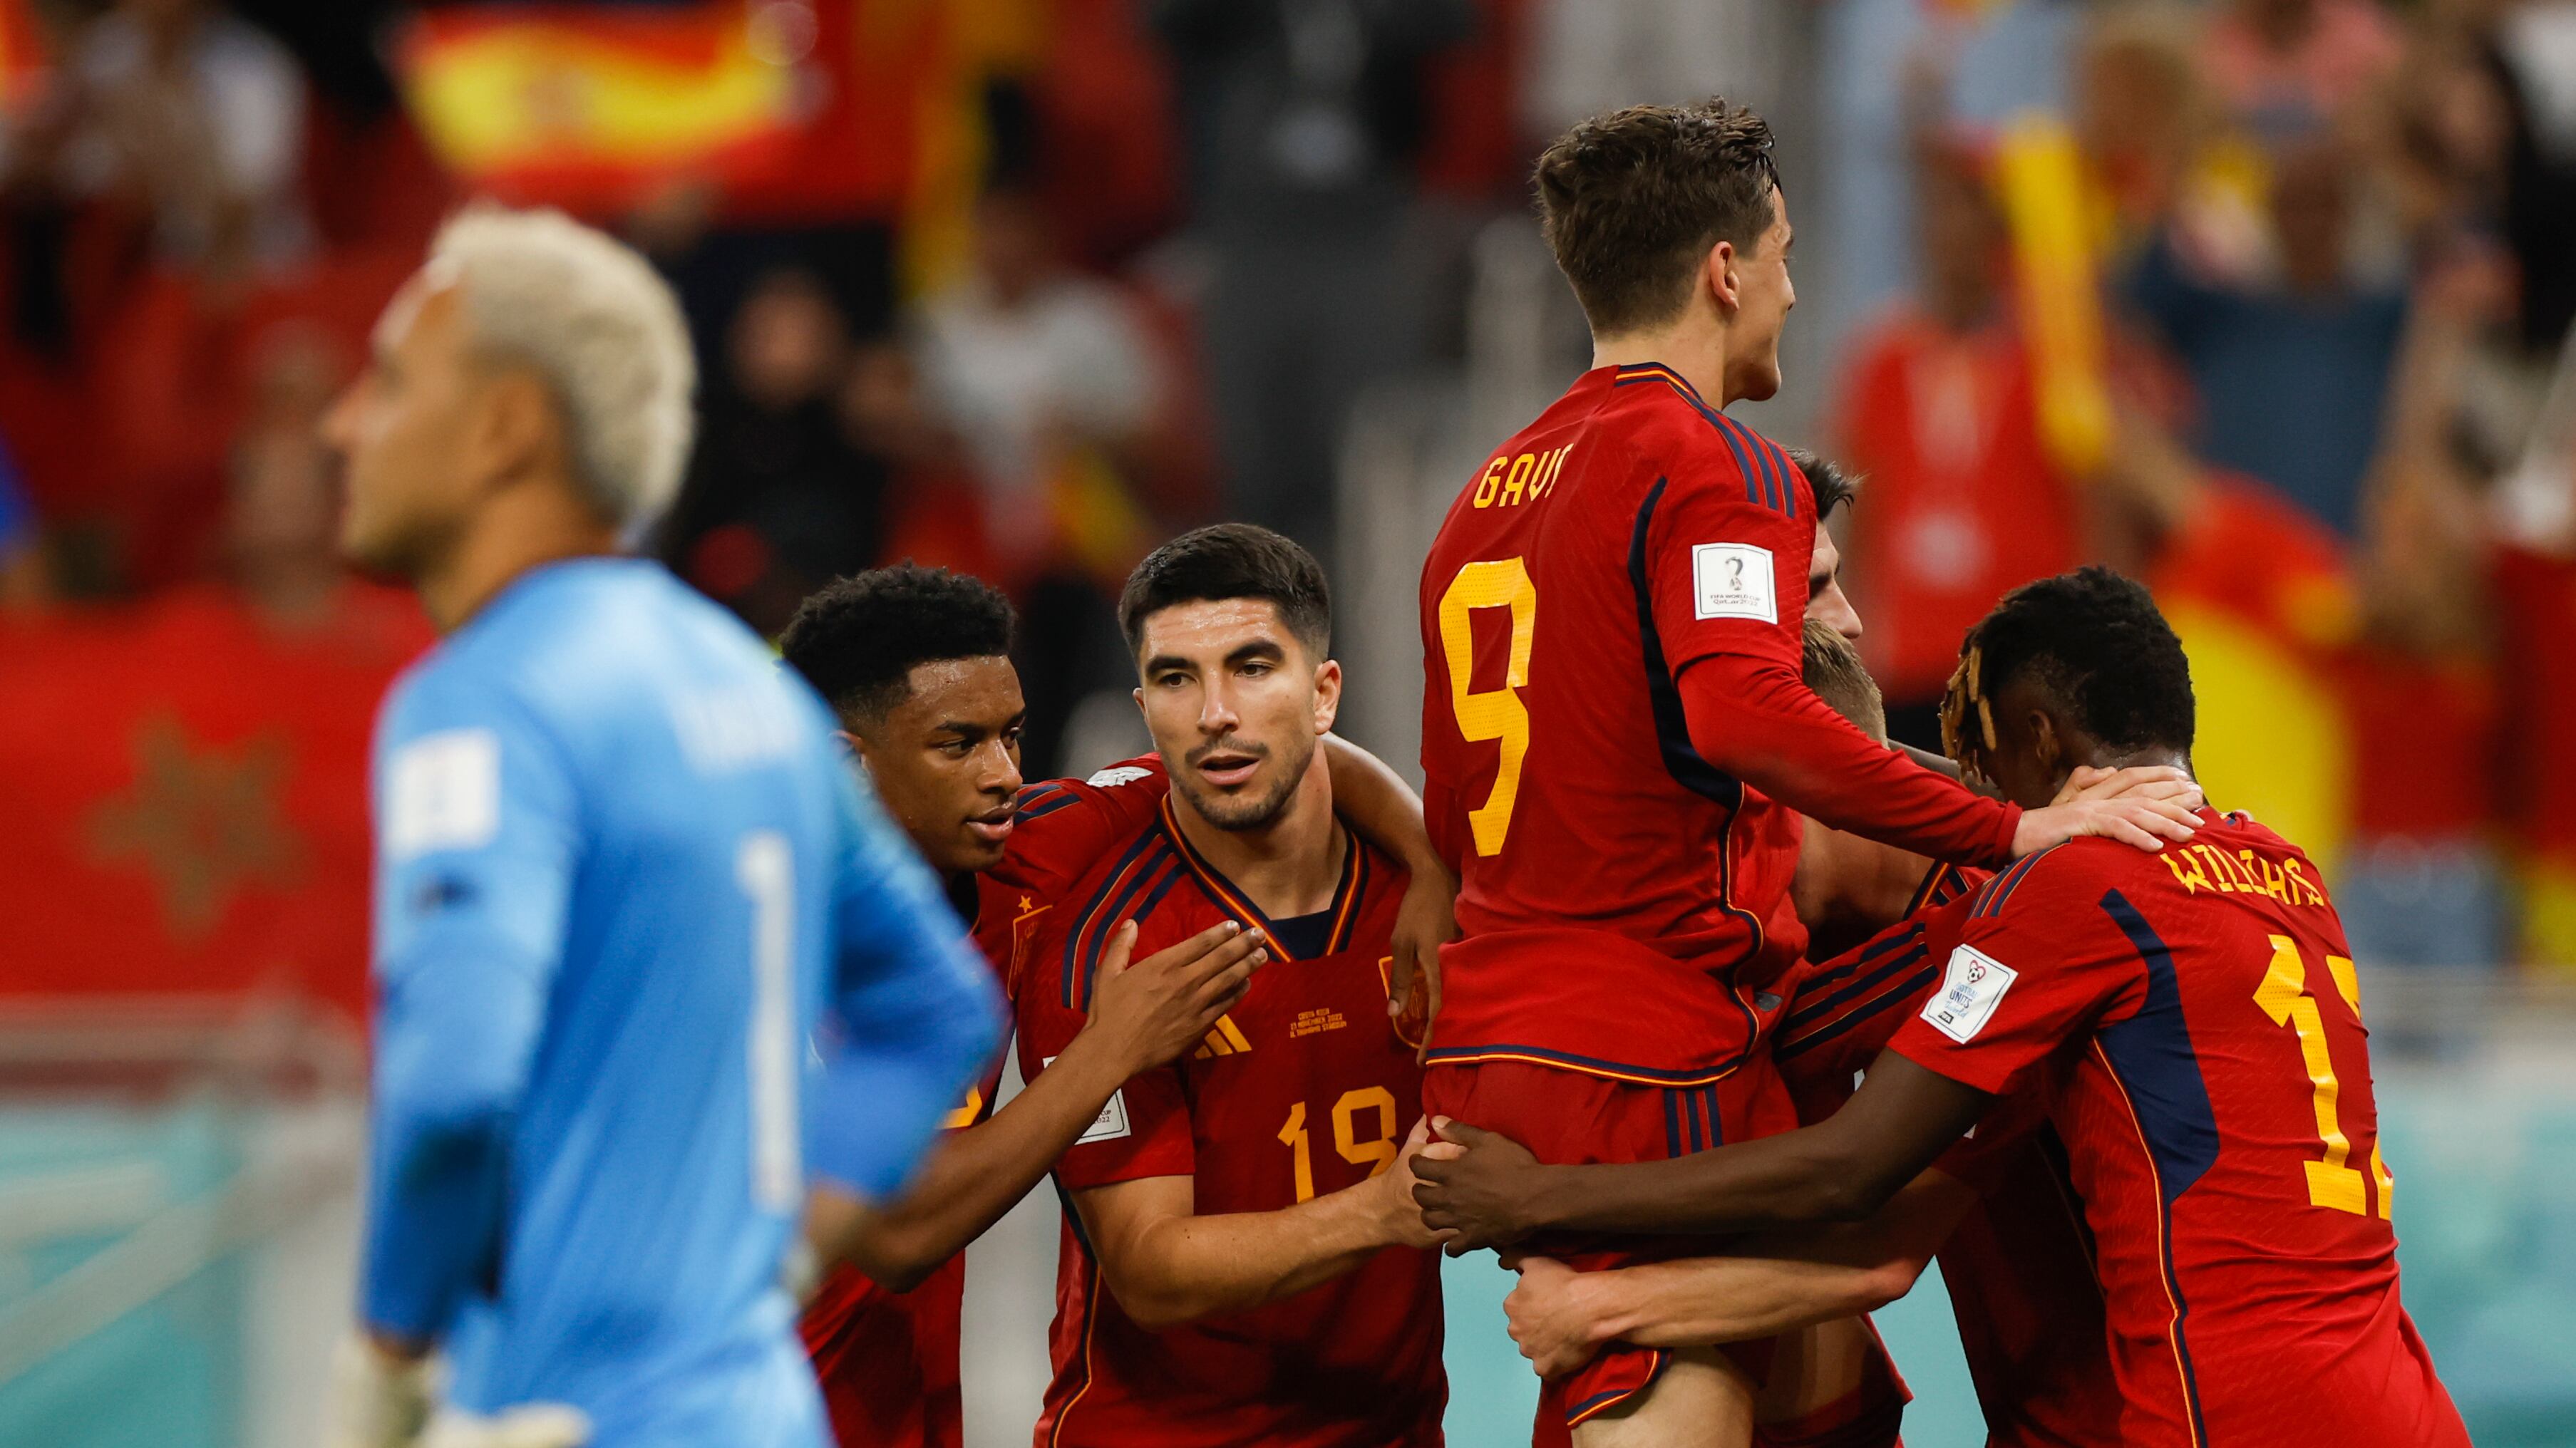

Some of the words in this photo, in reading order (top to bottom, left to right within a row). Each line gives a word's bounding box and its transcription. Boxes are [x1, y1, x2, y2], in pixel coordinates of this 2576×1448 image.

[1473, 443, 1575, 509] GAVI
[1438, 556, 1536, 857] 9
[737, 827, 803, 1216] 1
[1095, 1116, 1111, 1124] 022
[1277, 1085, 1397, 1204] 19
